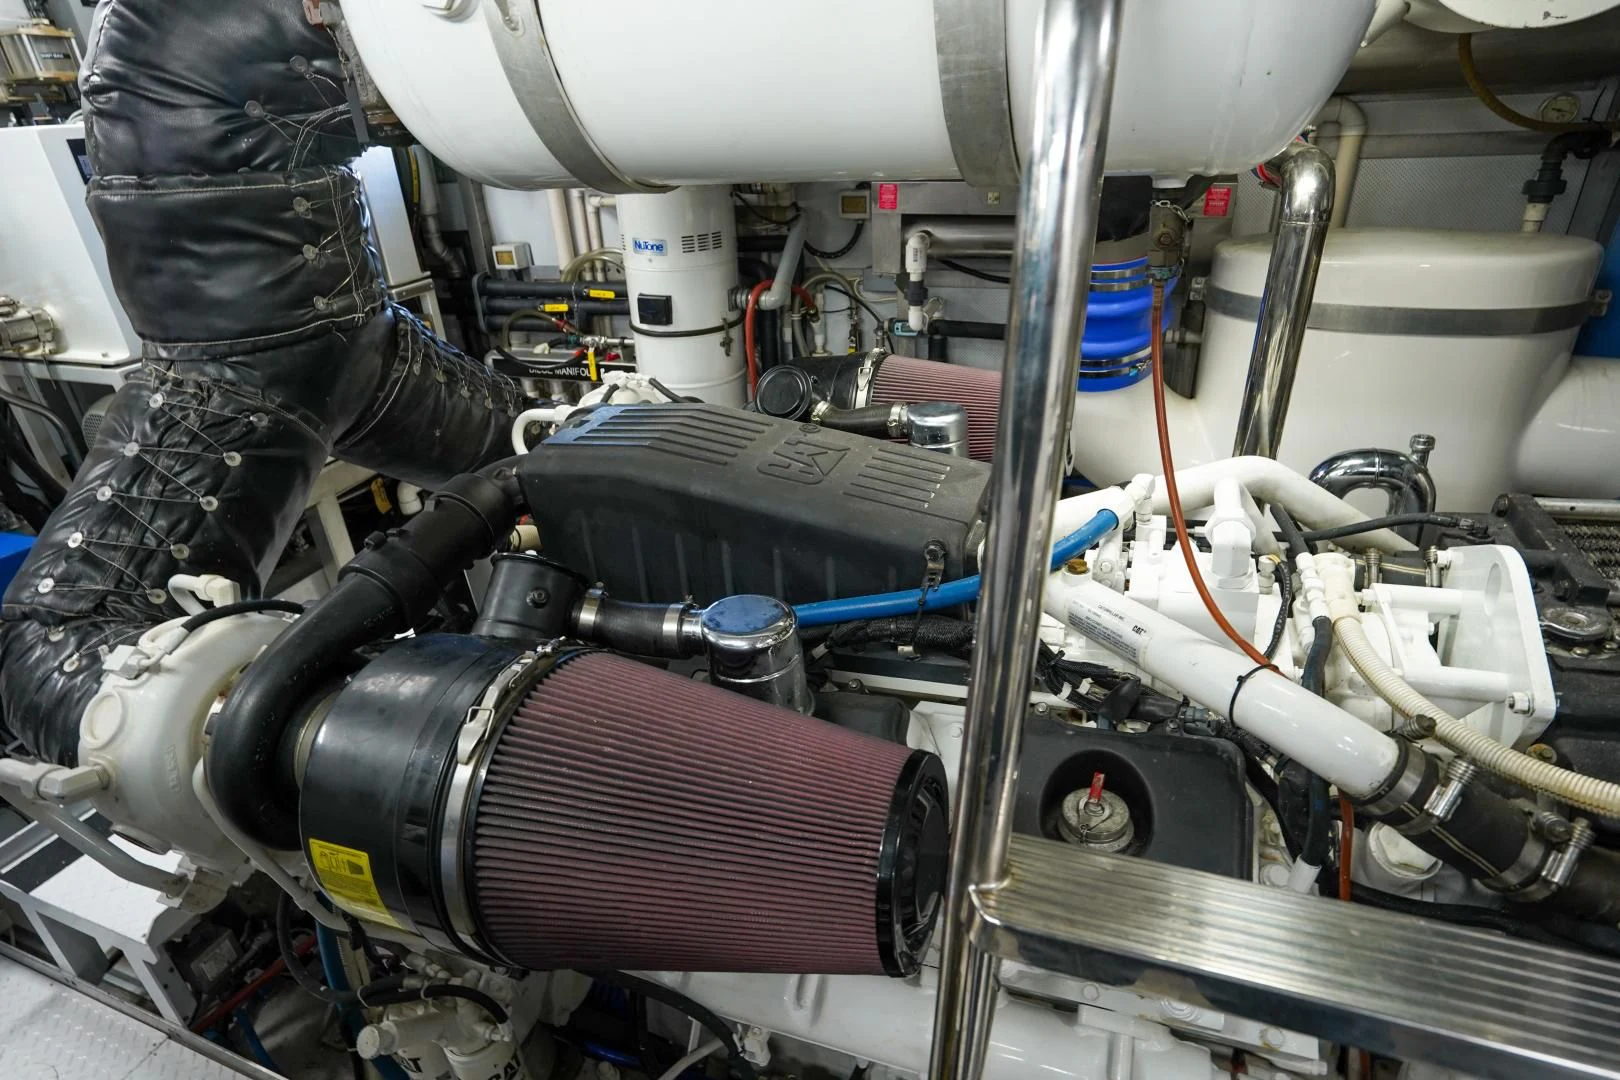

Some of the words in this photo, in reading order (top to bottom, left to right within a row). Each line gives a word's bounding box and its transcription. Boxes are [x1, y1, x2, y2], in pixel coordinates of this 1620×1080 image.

[634, 240, 664, 251] NuTone
[555, 367, 591, 377] MANIFOL
[757, 441, 851, 485] CAT
